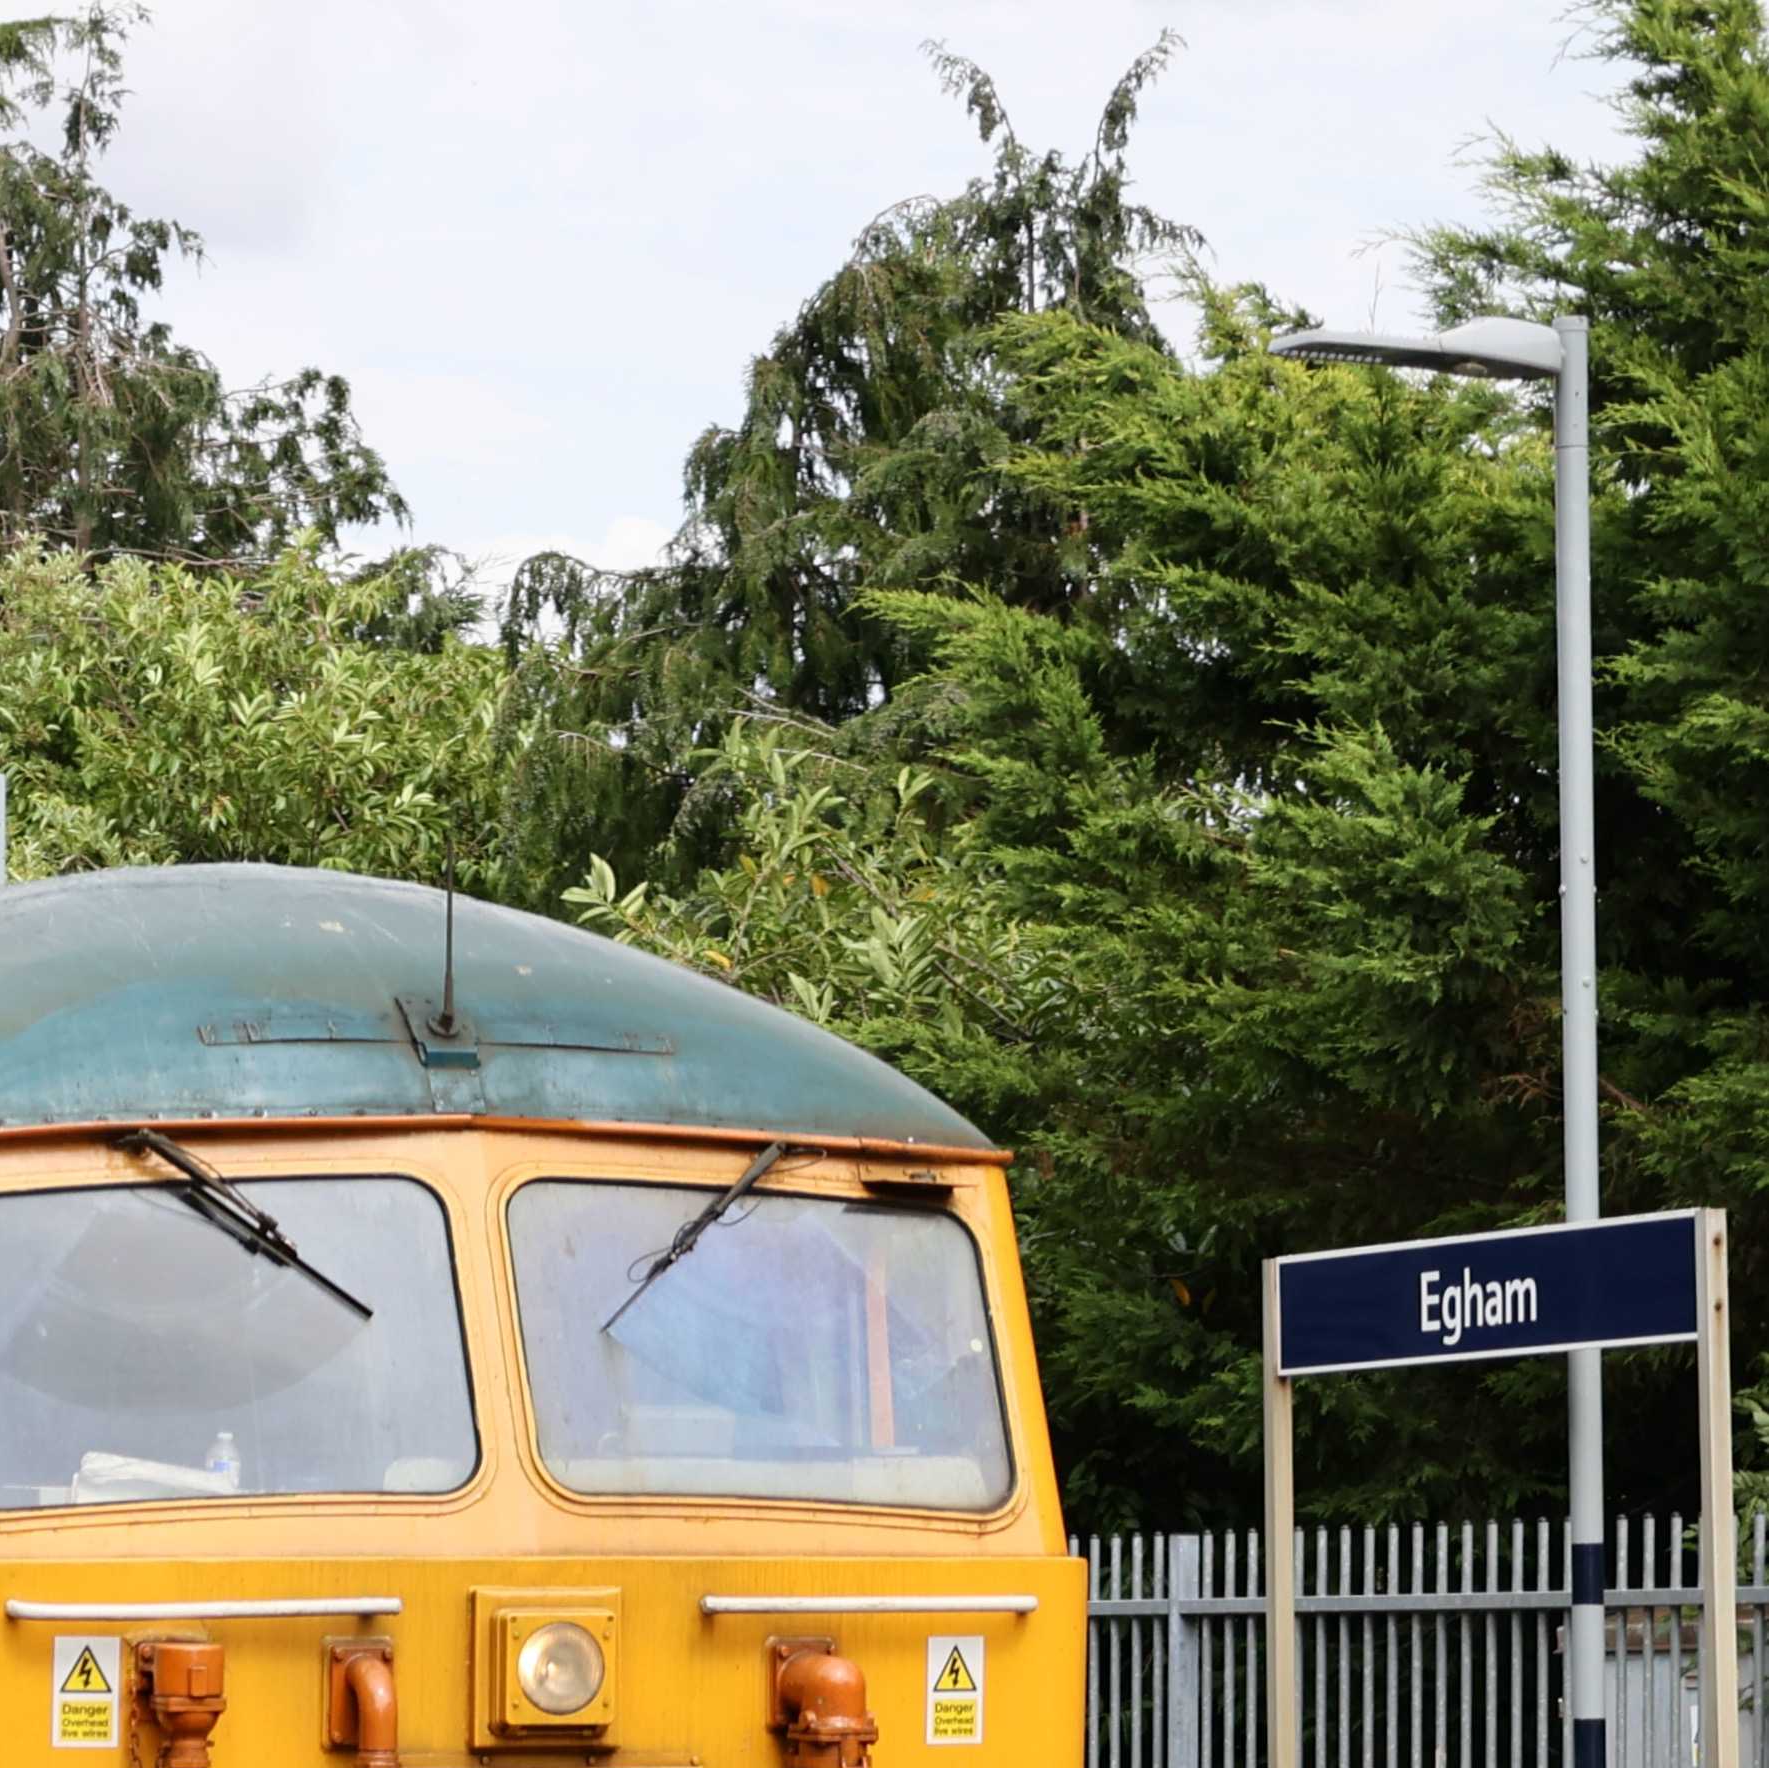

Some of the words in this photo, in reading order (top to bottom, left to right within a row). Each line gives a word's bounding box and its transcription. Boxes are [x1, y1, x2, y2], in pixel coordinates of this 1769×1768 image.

[1420, 1266, 1537, 1346] Egham
[62, 1704, 108, 1717] Danger
[935, 1703, 973, 1715] Danger
[62, 1718, 108, 1727] Overhead
[935, 1716, 974, 1725] Overhead
[62, 1728, 78, 1737] live
[83, 1729, 108, 1737] wires
[952, 1726, 973, 1735] wires
